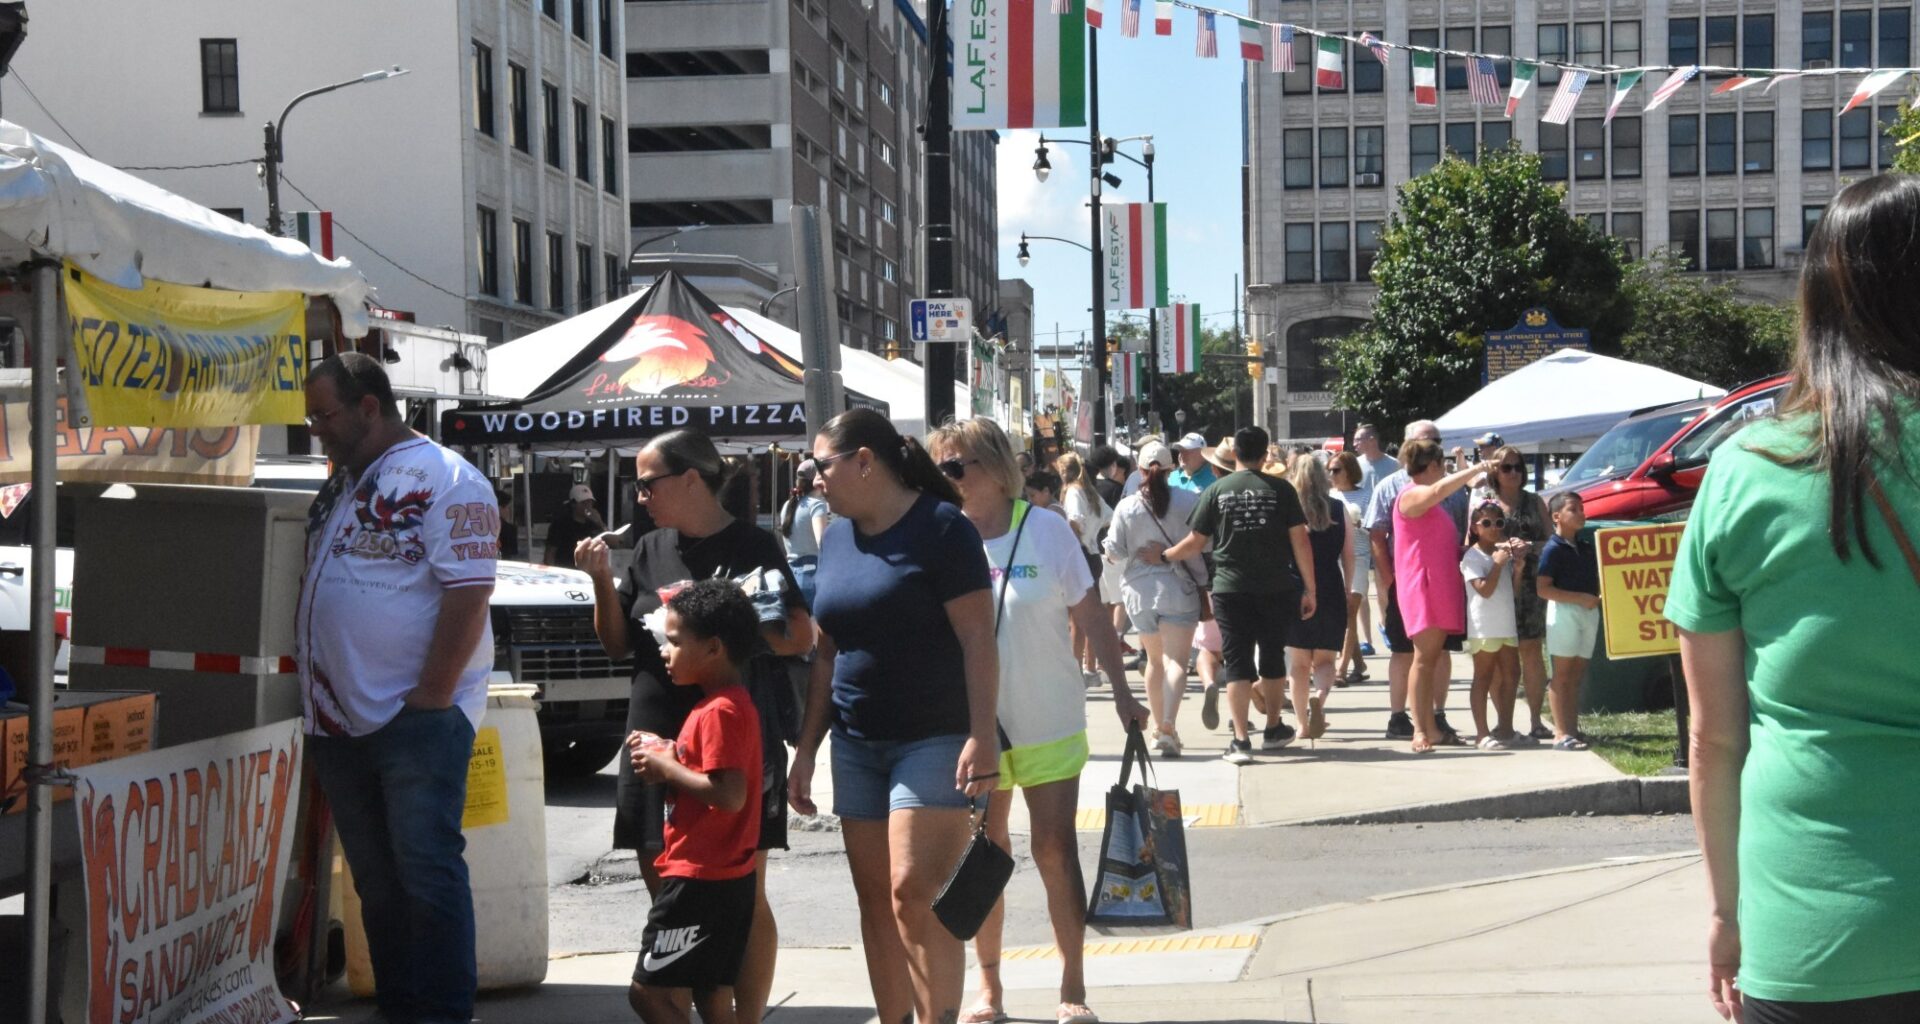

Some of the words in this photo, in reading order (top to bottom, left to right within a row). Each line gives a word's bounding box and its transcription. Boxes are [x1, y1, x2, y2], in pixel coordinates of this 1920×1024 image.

[1109, 223, 1120, 303] LAFESTA
[928, 310, 952, 318] HERE
[113, 322, 167, 390] TEA
[250, 334, 305, 392] PAER
[596, 394, 668, 404] WOODFIRED
[482, 406, 689, 433] WOODFIRED
[710, 403, 806, 425] PIZZA
[446, 502, 499, 540] 250
[357, 532, 395, 553] 250
[451, 542, 498, 561] YEAR
[1607, 531, 1682, 559] CAUT
[1621, 567, 1673, 590] WAT
[1633, 593, 1667, 616] YO
[1639, 620, 1681, 641] ST
[653, 924, 701, 954] NIKE
[120, 899, 254, 1023] SANDWICH
